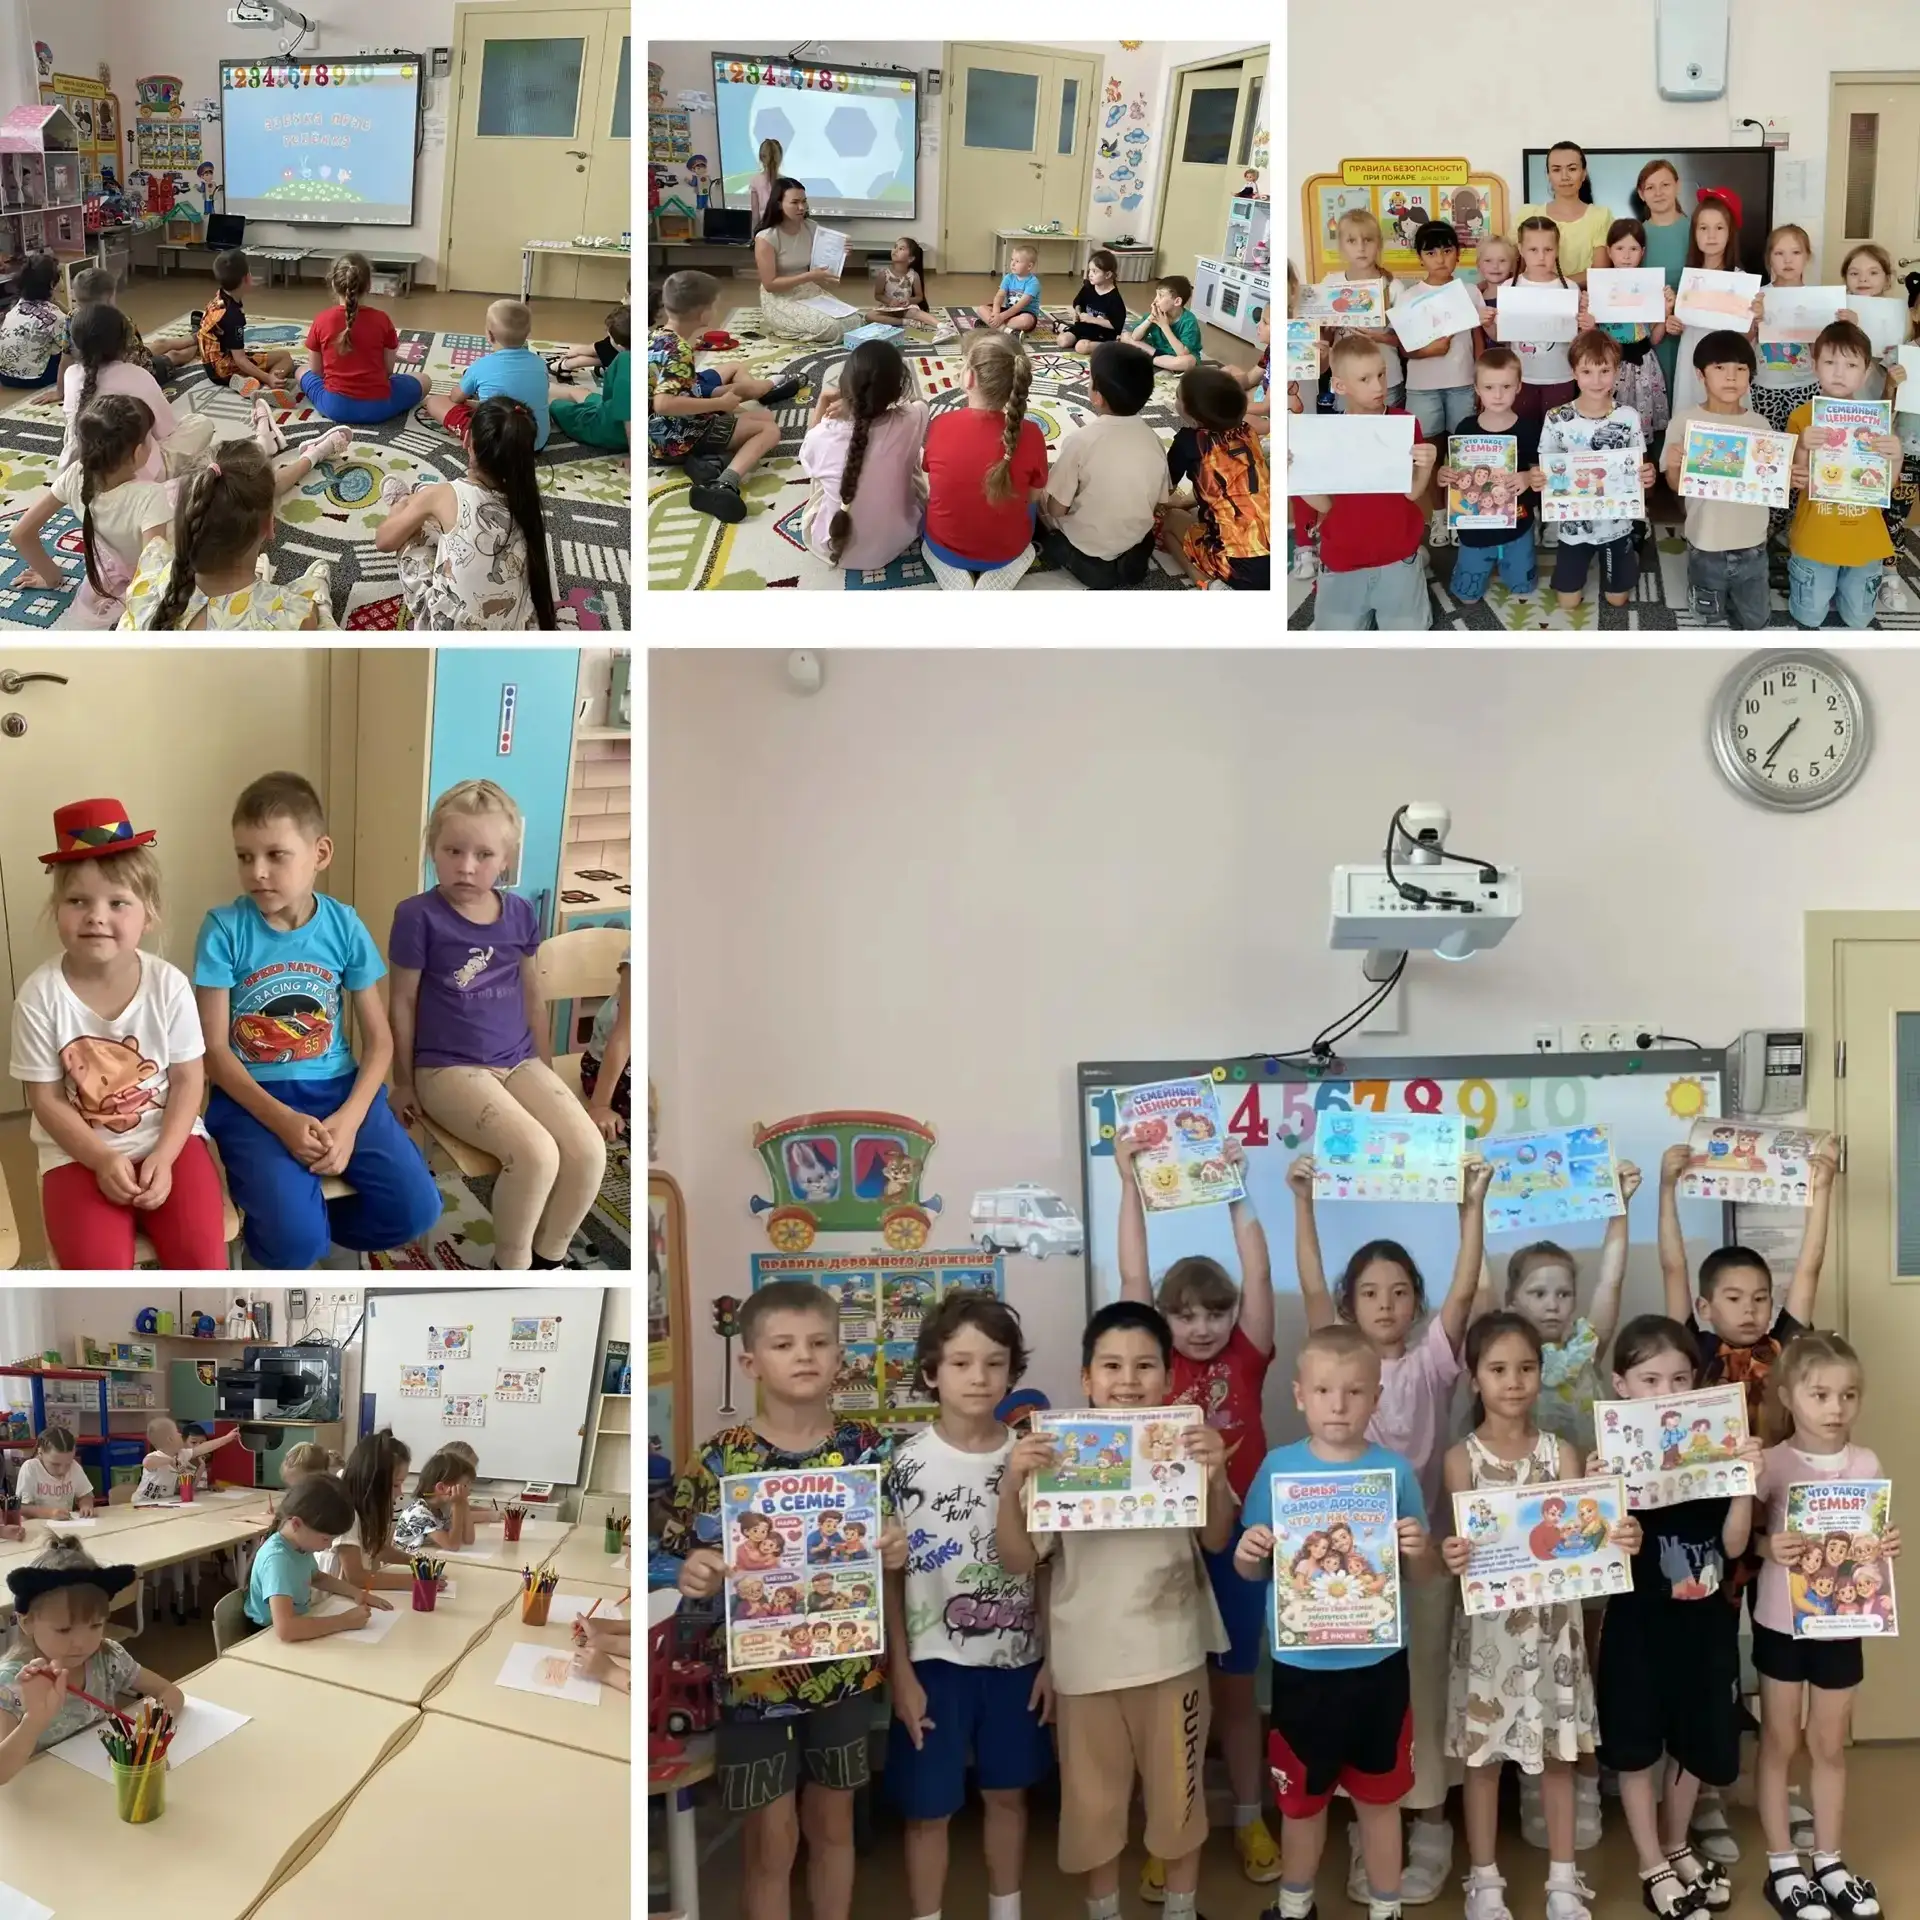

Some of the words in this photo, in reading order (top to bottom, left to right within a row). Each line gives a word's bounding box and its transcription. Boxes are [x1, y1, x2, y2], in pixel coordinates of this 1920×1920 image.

[234, 67, 247, 88] 2
[248, 66, 260, 88] 3
[262, 66, 274, 87] 4
[315, 64, 329, 86] 8
[332, 64, 346, 86] 9
[716, 61, 729, 84] 1
[729, 61, 744, 83] 2
[746, 63, 760, 85] 3
[762, 65, 776, 86] 4
[819, 69, 833, 91] 8
[837, 72, 849, 91] 9
[1349, 165, 1391, 173] ПРАВИЛА
[1393, 165, 1463, 173] БЕЗОПАСНОСТИ
[1381, 174, 1416, 182] ПОЖАРЕ
[1411, 196, 1422, 205] 01
[1826, 405, 1879, 416] СЕМЕЙНЫЕ
[1825, 414, 1881, 425] ЦЕННОСТИ
[1464, 444, 1503, 453] СЕМЬЯ?
[1816, 503, 1833, 515] THE
[1781, 671, 1796, 687] 12
[1812, 678, 1817, 694] 1
[1763, 680, 1774, 696] 11
[1745, 699, 1760, 715] 10
[1826, 695, 1837, 711] 2
[1737, 724, 1748, 739] 9
[1833, 720, 1844, 735] 3
[1746, 748, 1757, 763] 8
[1824, 744, 1837, 760] 4
[1788, 767, 1799, 783] 6
[1809, 761, 1820, 777] 5
[1133, 1087, 1197, 1104] СЕМЕЙНЫЕ
[1134, 1098, 1203, 1116] ЦЕННОСТИ
[1228, 1083, 1269, 1146] 4
[1278, 1082, 1317, 1142] 5
[1457, 1077, 1497, 1138] 9
[760, 1257, 824, 1270] ПРАВИЛА
[829, 1256, 913, 1269] ДОРОЖНОГО
[919, 1255, 994, 1268] ДВИЖЕНИЯ
[764, 1475, 834, 1497] РОЛИ
[1288, 1484, 1337, 1499] Семья
[1353, 1484, 1378, 1496] это
[1808, 1487, 1829, 1497] ЧТО
[1833, 1486, 1866, 1497] ТАКОЕ
[762, 1500, 776, 1514] В
[780, 1494, 846, 1512] СЕМЬЕ
[1281, 1499, 1326, 1514] самое
[1808, 1498, 1867, 1512] СЕМЬЯ?
[1288, 1513, 1311, 1526] что
[1315, 1513, 1323, 1525] у
[1327, 1511, 1348, 1523] нас
